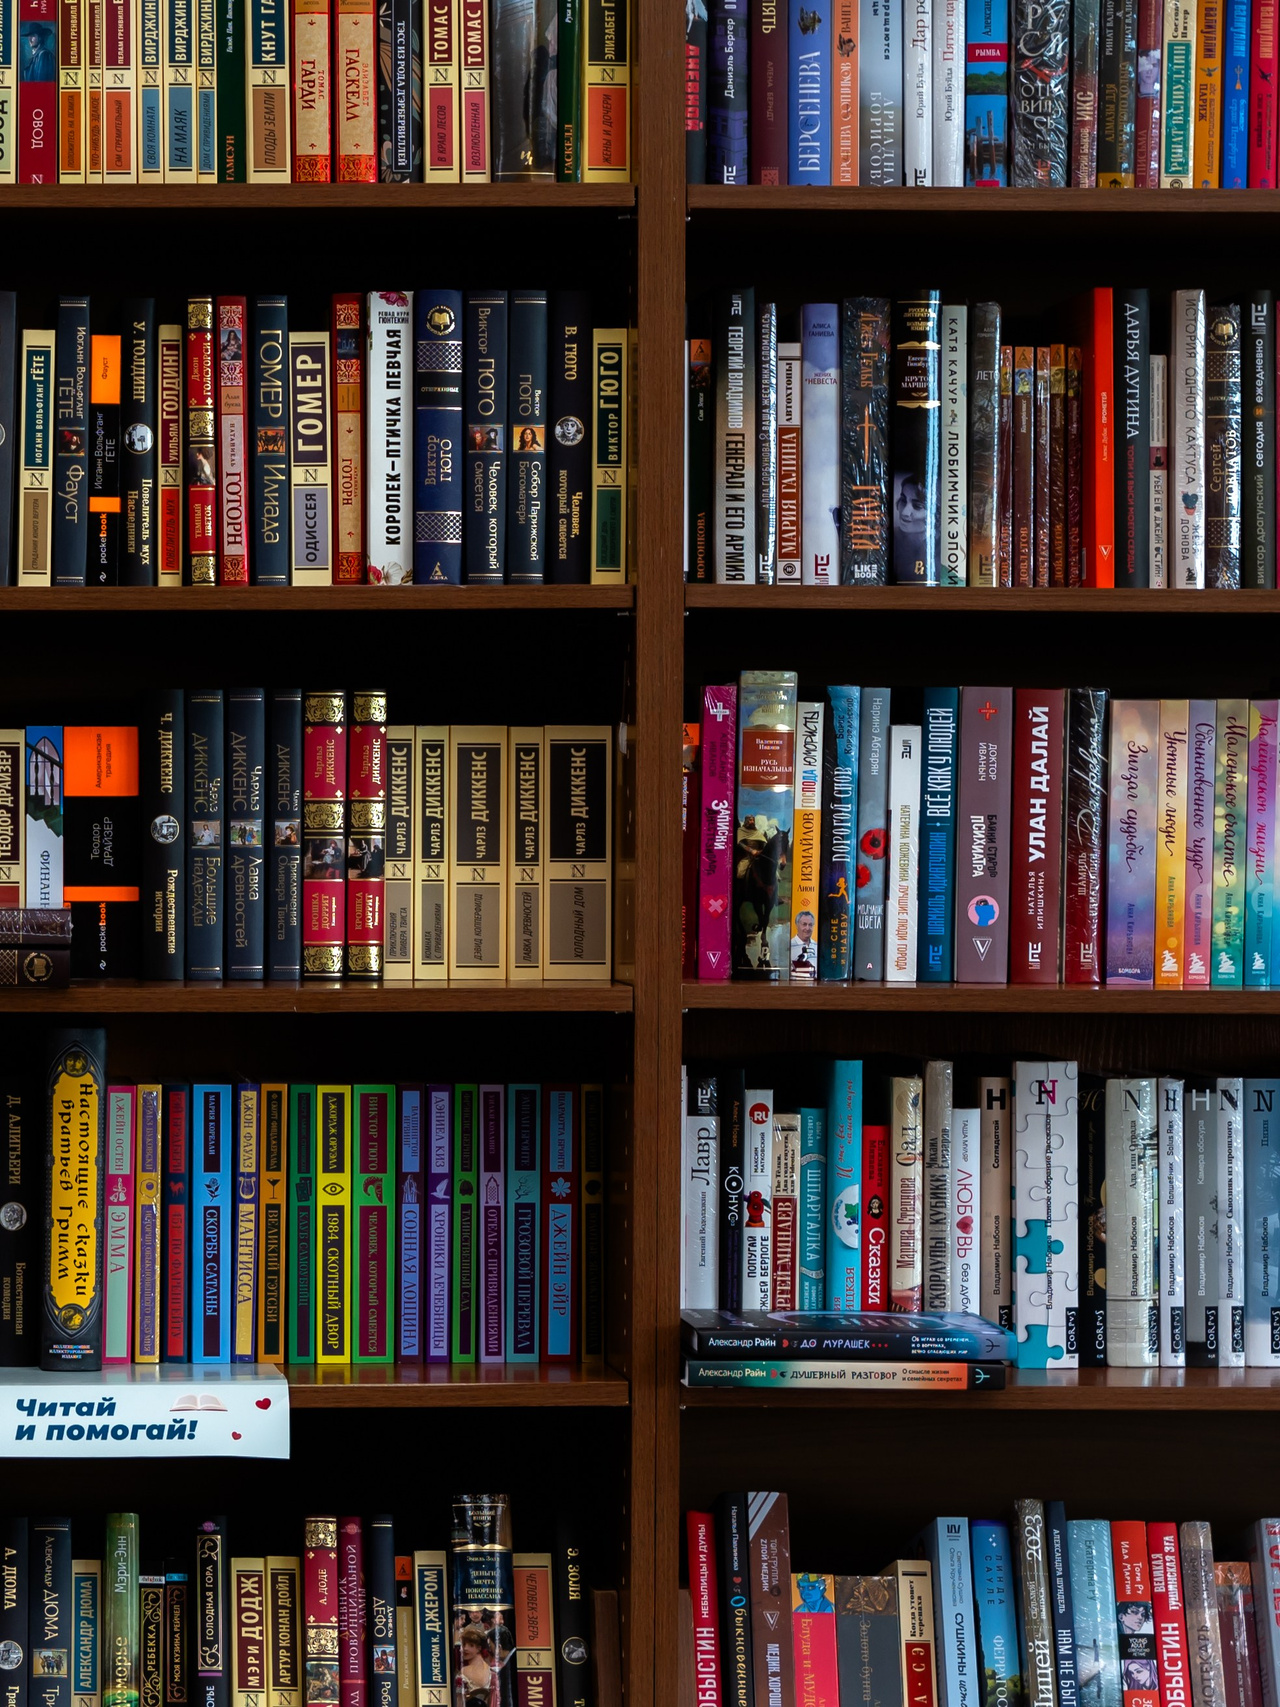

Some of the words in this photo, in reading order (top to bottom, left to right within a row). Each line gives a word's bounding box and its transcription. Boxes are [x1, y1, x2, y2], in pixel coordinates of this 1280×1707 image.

[726, 19, 734, 53] Бергер
[975, 49, 1001, 57] РЫМБА
[301, 60, 316, 110] ГАРДИ
[346, 49, 360, 121] ГАСКЕЛЛ
[724, 55, 734, 99] Даниэль
[31, 109, 43, 149] ОВОД
[176, 109, 187, 141] МАЯК
[799, 51, 821, 171] БЕРСЕНЕВА
[175, 145, 186, 163] НА
[226, 136, 234, 181] ГАМСУН
[728, 327, 743, 368] ГЕОРГИЙ
[1124, 304, 1139, 359] ДАРЬЯ
[260, 330, 282, 417] ГОМЕР
[387, 329, 401, 389] ПЕВЧАЯ
[949, 359, 957, 404] КАЧУР
[297, 355, 323, 452] ГОМЕР
[728, 372, 743, 428] ВЛАДИМОВ
[1124, 367, 1139, 439] ДУГИНА
[726, 433, 745, 488] ГЕНЕРАЛ
[782, 432, 796, 499] ГАЛИНА
[948, 432, 958, 524] ЛЮБИМЧИК
[226, 472, 241, 546] ГОТОРН
[725, 506, 745, 529] ЕГО
[726, 493, 745, 502] И
[306, 493, 319, 562] ОДИССЕЯ
[782, 508, 796, 554] МАРИЯ
[725, 534, 745, 581] АРМИЯ
[948, 531, 958, 584] ЭПОХИ
[1029, 706, 1049, 792] ДАЛАЙ
[571, 748, 588, 818] ДИККЕНС
[576, 822, 585, 855] ЧАРЛЗ
[802, 813, 814, 880] ИЗМАЙЛОВ
[1029, 799, 1045, 862] УЛАН
[168, 869, 178, 954] Рождественские
[574, 887, 584, 908] ДОМ
[574, 912, 584, 959] ХОЛОДНЫЙ
[690, 1127, 717, 1186] Лавр
[206, 1210, 218, 1259] СКОРБЬ
[807, 1169, 821, 1261] ШПАРГАЛКА
[110, 1212, 125, 1273] ЭММА
[238, 1210, 253, 1304] МАНТИССА
[552, 1210, 567, 1276] ДЖЕЙН
[868, 1227, 886, 1304] Сказки
[206, 1264, 218, 1316] САТАНЫ
[553, 1283, 567, 1316] ЭЙР
[1198, 1251, 1206, 1296] Владимир
[709, 1338, 753, 1348] Александр
[755, 1338, 776, 1348] Райн
[699, 1368, 743, 1378] Александр
[745, 1368, 766, 1377] Райн
[790, 1369, 846, 1379] ДУШЕВНЫЙ
[851, 1371, 896, 1380] РАЗГОВОР
[15, 1397, 115, 1417] Читай
[15, 1425, 34, 1440] и
[46, 1420, 198, 1444] помогай!
[1025, 1514, 1043, 1561] 2023
[115, 1536, 130, 1593] Мэри-Энн
[568, 1565, 580, 1600] ЗОЛЯ
[242, 1577, 263, 1639] ДОДЖ
[347, 1544, 359, 1673] ПРОВИНЦИАЛЬНОЙ
[426, 1570, 439, 1631] ДЖЕРОМ
[247, 1646, 260, 1687] МЭРИ
[433, 1651, 442, 1682] ДЖЕРОМ
[955, 1613, 966, 1676] СУШКИНЫ
